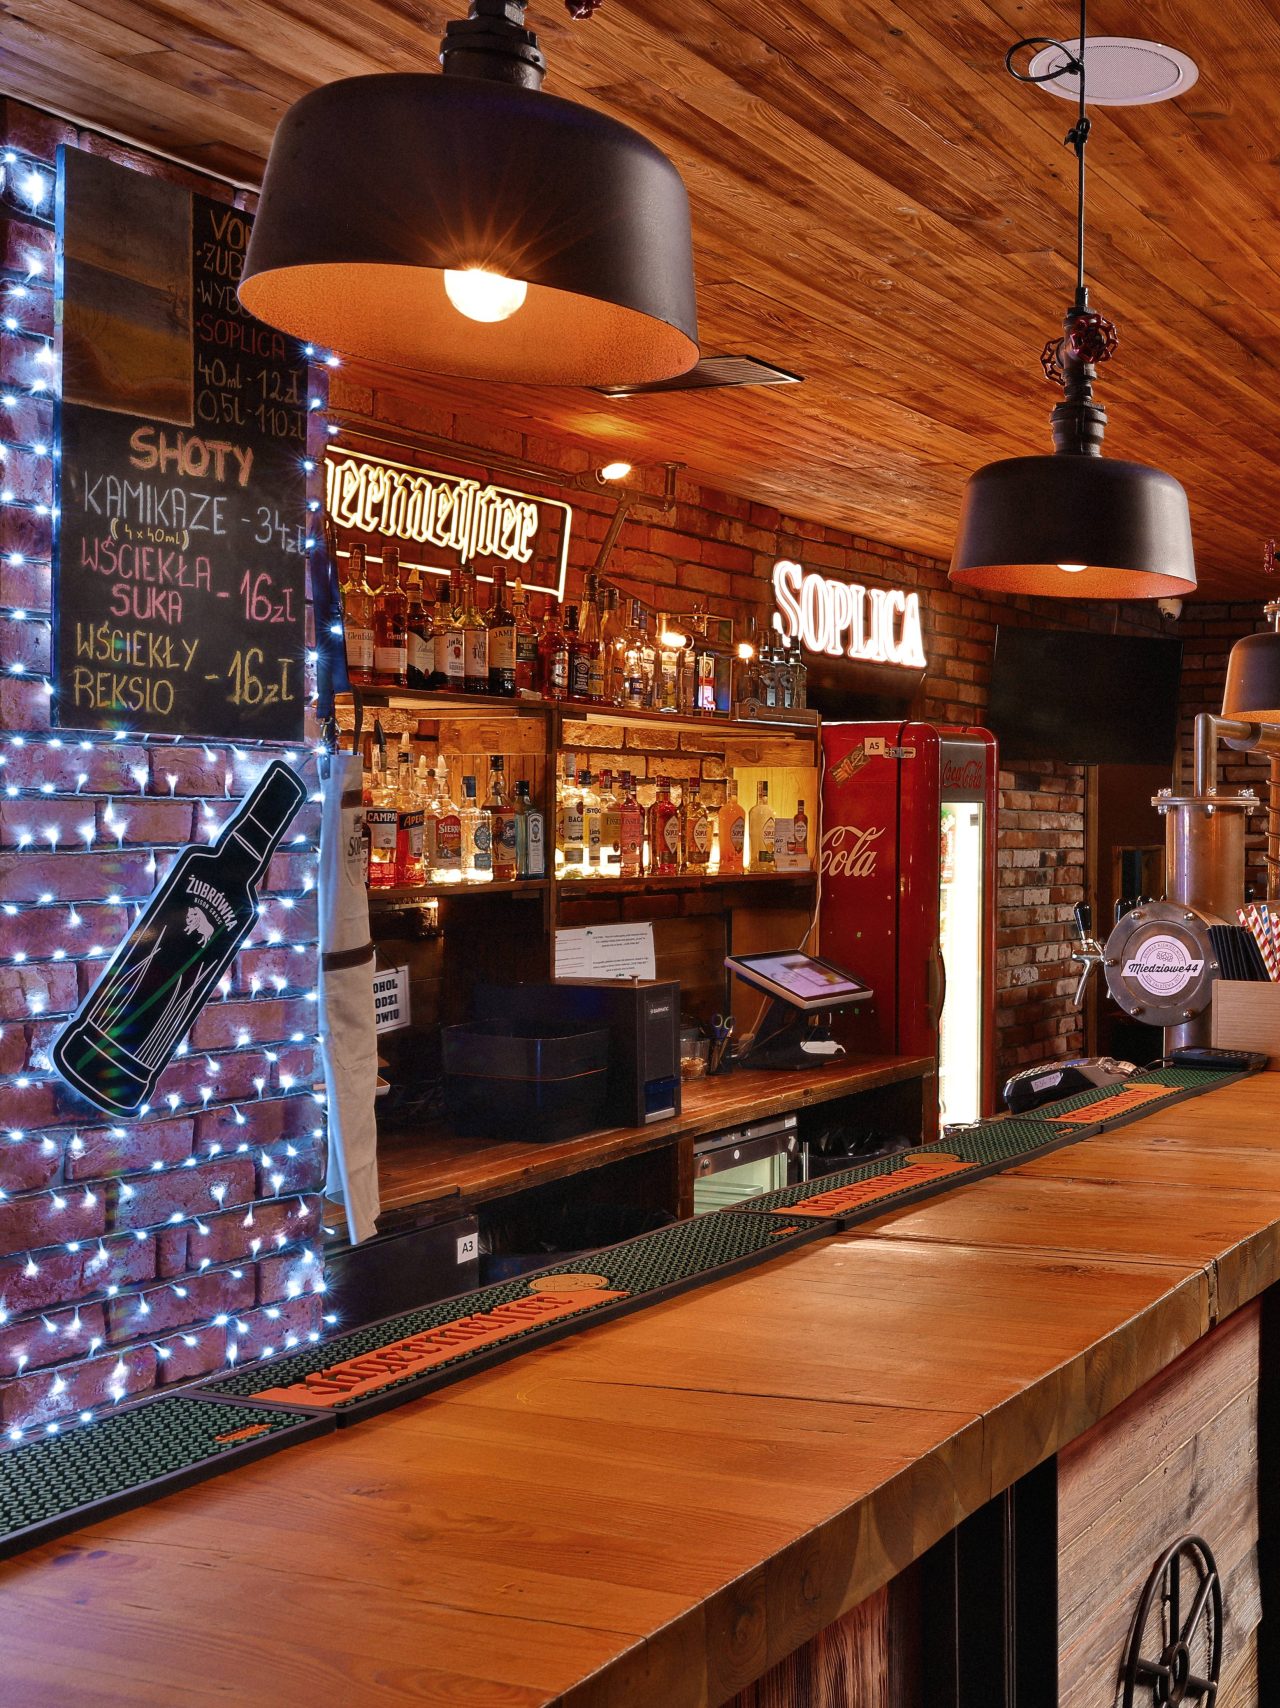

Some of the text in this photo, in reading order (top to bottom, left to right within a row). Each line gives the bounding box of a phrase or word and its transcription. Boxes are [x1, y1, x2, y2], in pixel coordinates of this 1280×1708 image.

[203, 242, 246, 281] ZUB
[201, 314, 286, 360] SOPLICA
[129, 425, 254, 487] SHOTY
[83, 469, 228, 535] KAMIKAZE
[81, 535, 211, 592] WŚCIEKŁA
[110, 583, 183, 625] SUKA
[773, 560, 927, 668] SOPLICA
[76, 621, 200, 672] WŚCIEKŁY
[73, 666, 174, 715] REKSIO
[868, 742, 880, 750] A5
[186, 874, 238, 932] ŻUBRÓWKA
[1128, 963, 1199, 975] Miedziowe44
[462, 1240, 473, 1254] A3
